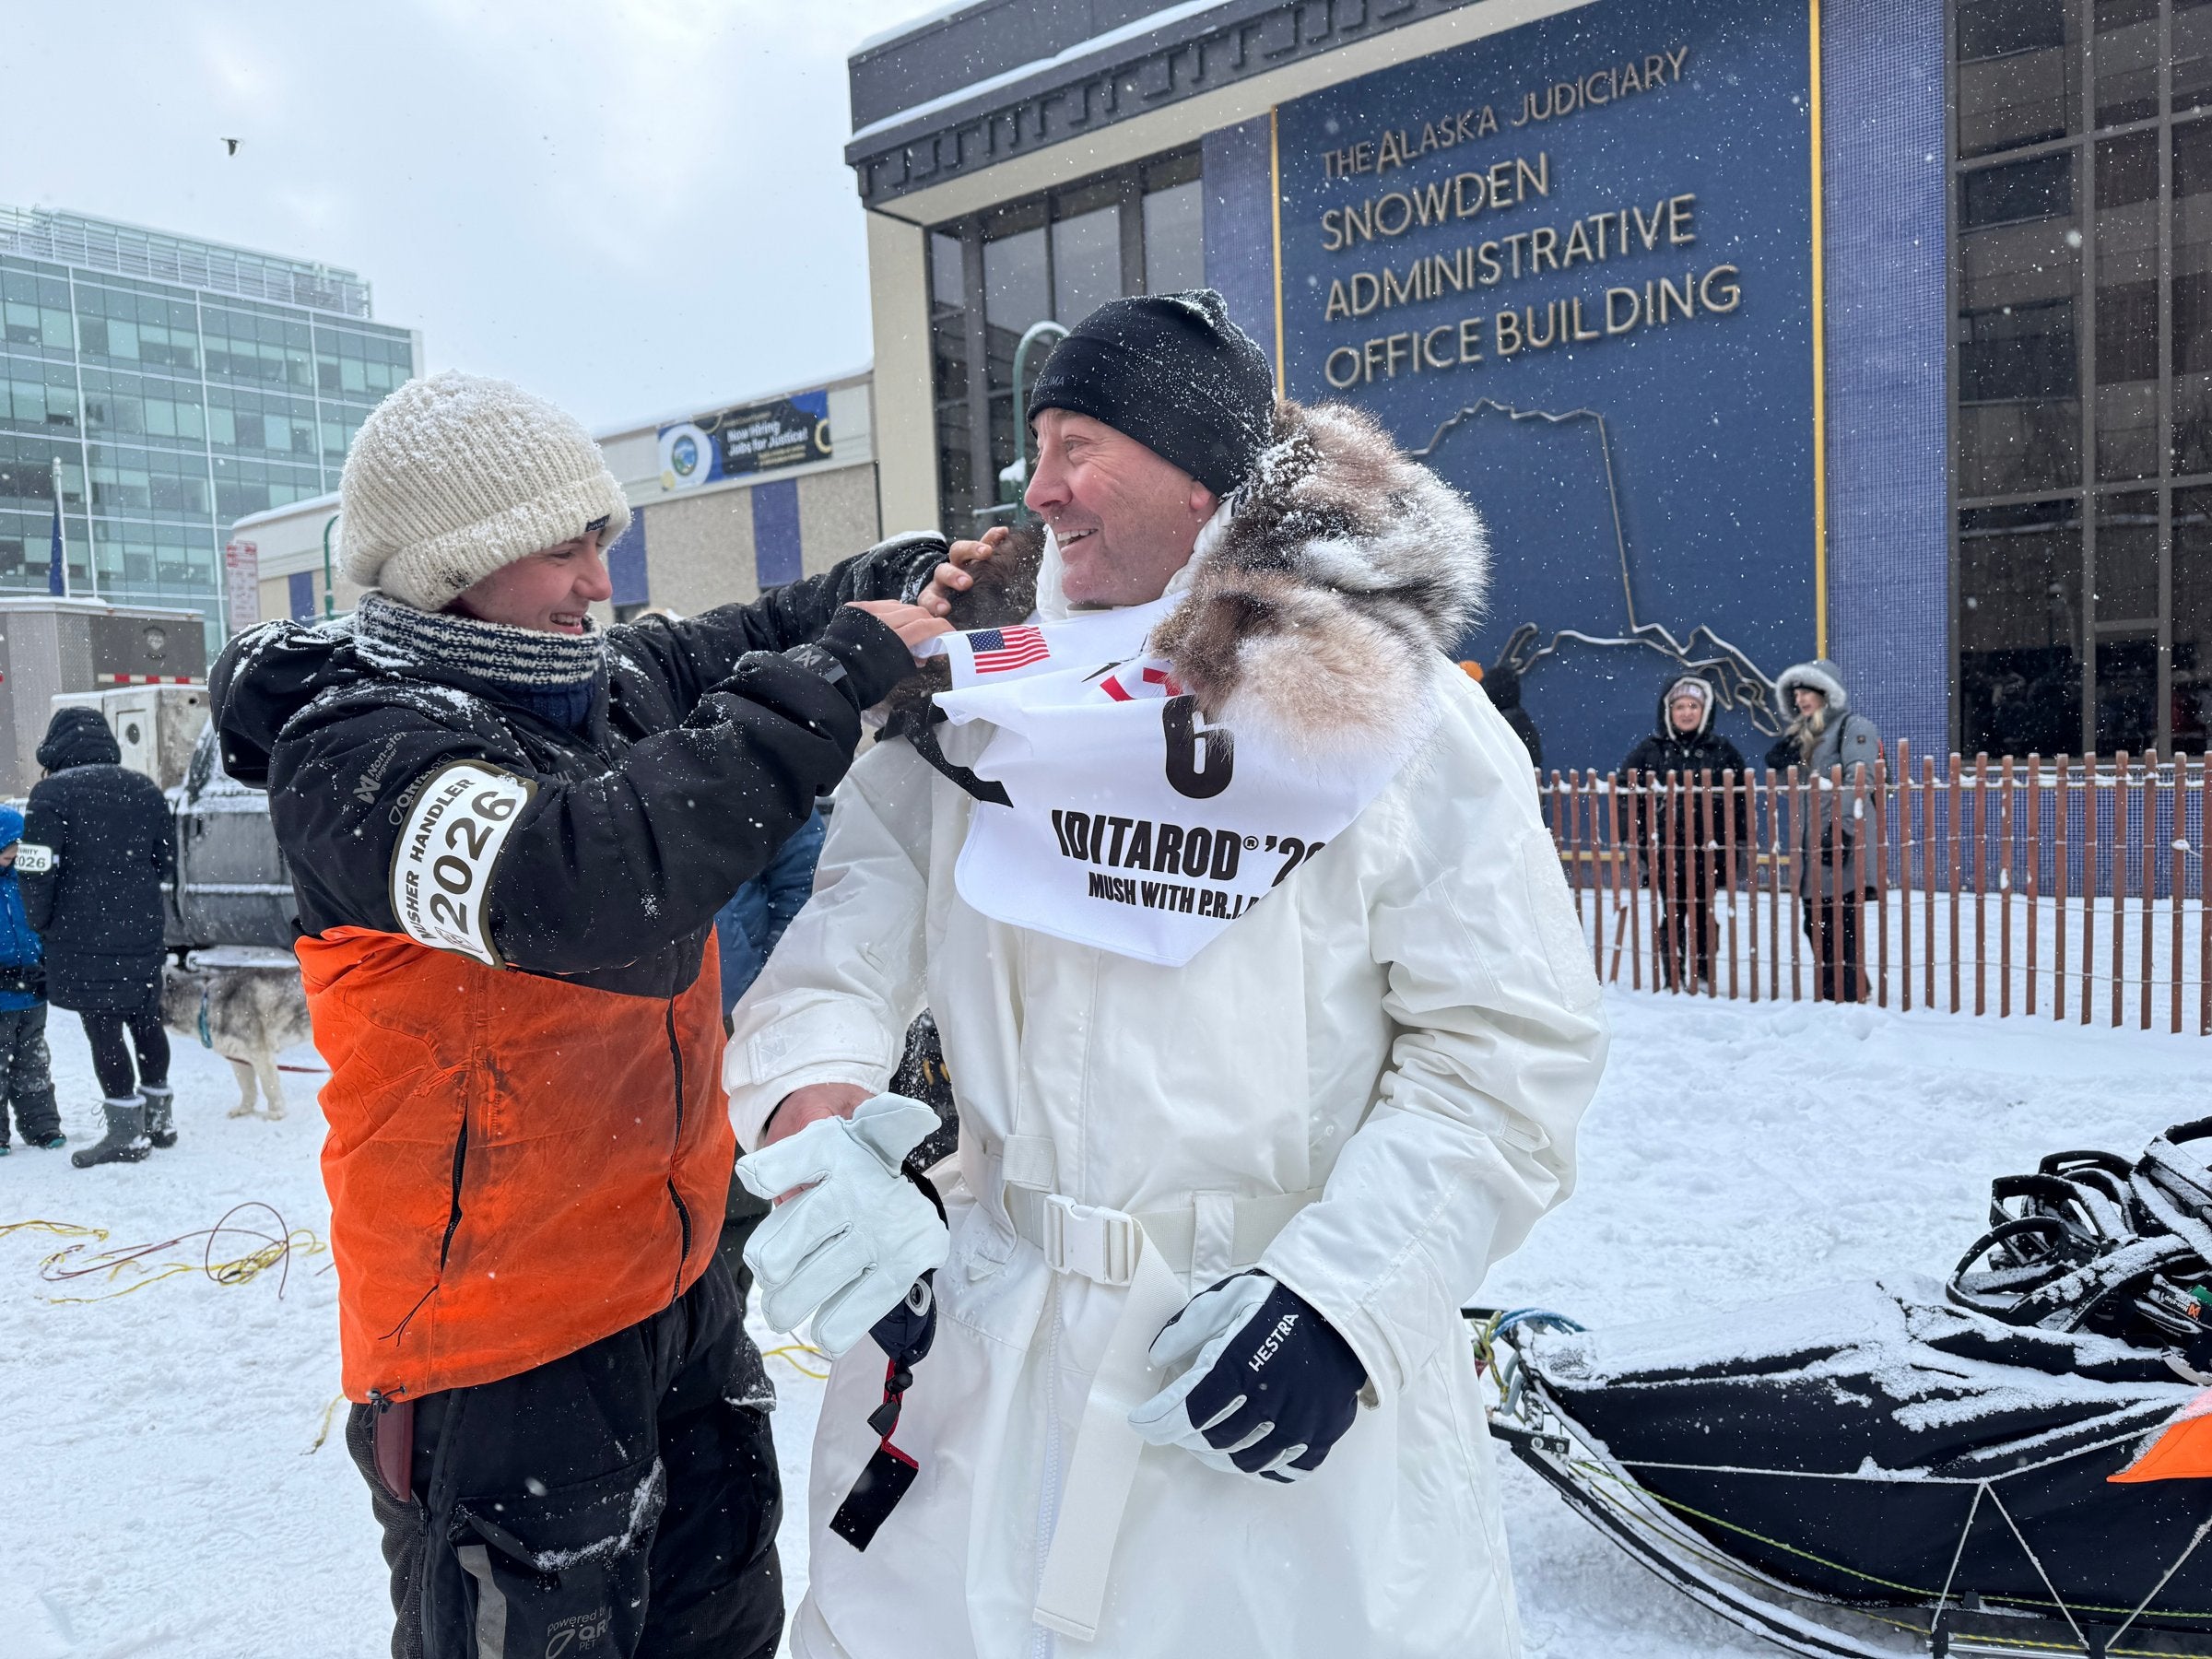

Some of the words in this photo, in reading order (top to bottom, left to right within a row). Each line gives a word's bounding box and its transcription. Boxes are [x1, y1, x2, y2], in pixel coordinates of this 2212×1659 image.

[1322, 142, 1373, 182] THE
[1376, 104, 1500, 174] ALASKA
[1511, 45, 1690, 128] JUDICIARY
[1321, 151, 1549, 252] SNOWDEN
[1324, 193, 1698, 323] ADMINISTRATIVE
[1324, 317, 1483, 390] OFFICE
[1496, 264, 1741, 356] BUILDING
[726, 428, 749, 442] Now
[749, 420, 782, 437] Hiring
[728, 443, 752, 456] Jobs
[752, 439, 768, 452] for
[768, 426, 808, 449] Justice!
[1162, 694, 1235, 800] 6
[410, 778, 477, 863] HANDLER
[429, 791, 517, 935] 2026
[406, 870, 438, 938] MUSHER
[1088, 871, 1136, 906] MUSH
[1141, 880, 1196, 913] WITH
[1248, 1313, 1299, 1372] HESTRA
[547, 1609, 597, 1637] powered
